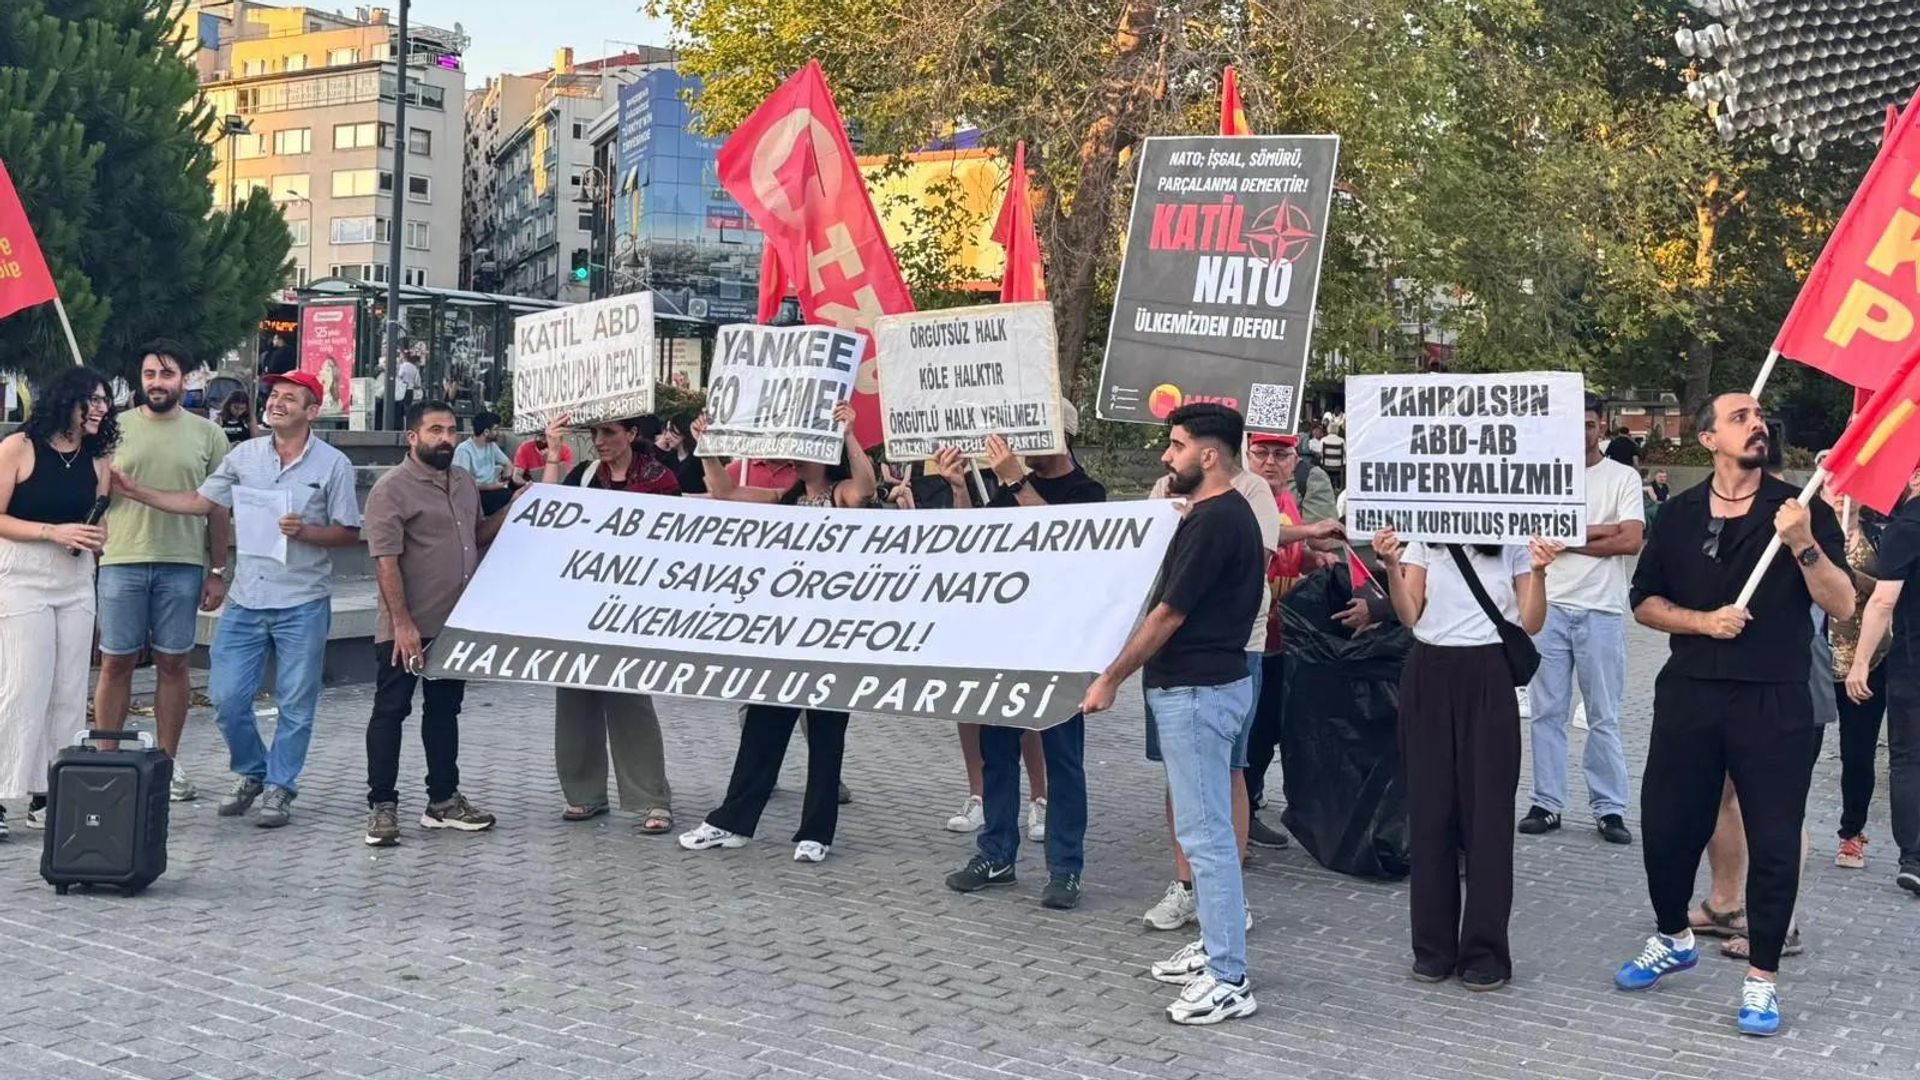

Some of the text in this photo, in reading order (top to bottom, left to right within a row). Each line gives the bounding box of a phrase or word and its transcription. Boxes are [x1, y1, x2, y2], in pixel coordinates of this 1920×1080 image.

[1169, 148, 1302, 169] NATO; İŞGAL, SÖMÜRÜ,
[1157, 174, 1309, 195] PARÇALANMA DEMEKTİR!
[1149, 194, 1247, 253] KATİL
[1193, 255, 1293, 307] NATO
[520, 303, 640, 356] KATİL ABD
[910, 317, 1008, 349] ÖRGÜTSÜZ HALK
[1134, 308, 1287, 340] ÜLKEMİZDEN DEFOL!
[606, 346, 645, 393] DEFOL!
[723, 330, 857, 373] YANKEE
[919, 362, 1005, 390] KÖLE HALKTIR
[707, 374, 848, 433] GO HOME!
[1380, 384, 1549, 417] KAHROLSUN
[889, 405, 940, 435] ÖRGÜTLÜ
[945, 406, 977, 432] HALK
[890, 432, 1054, 455] HALKIN KURTUL PARTİSİ
[1410, 424, 1517, 455] ABD-AB
[1360, 458, 1574, 496] EMPERYALİZMİ!
[595, 506, 645, 537] AB
[647, 511, 862, 553] EMPERYALİST
[860, 516, 1154, 554] HAYDUTLARININ
[1355, 509, 1577, 540] HALKIN KURTULUŞ PARTİSİ
[560, 549, 1030, 604] KANLI SAVAŞ ÖRGÜTÜ NATO
[587, 594, 935, 652] ÜLKEMİZDEN DEFOL!
[442, 640, 1060, 719] HALKIN KURTULUŞ PARTİSİ
